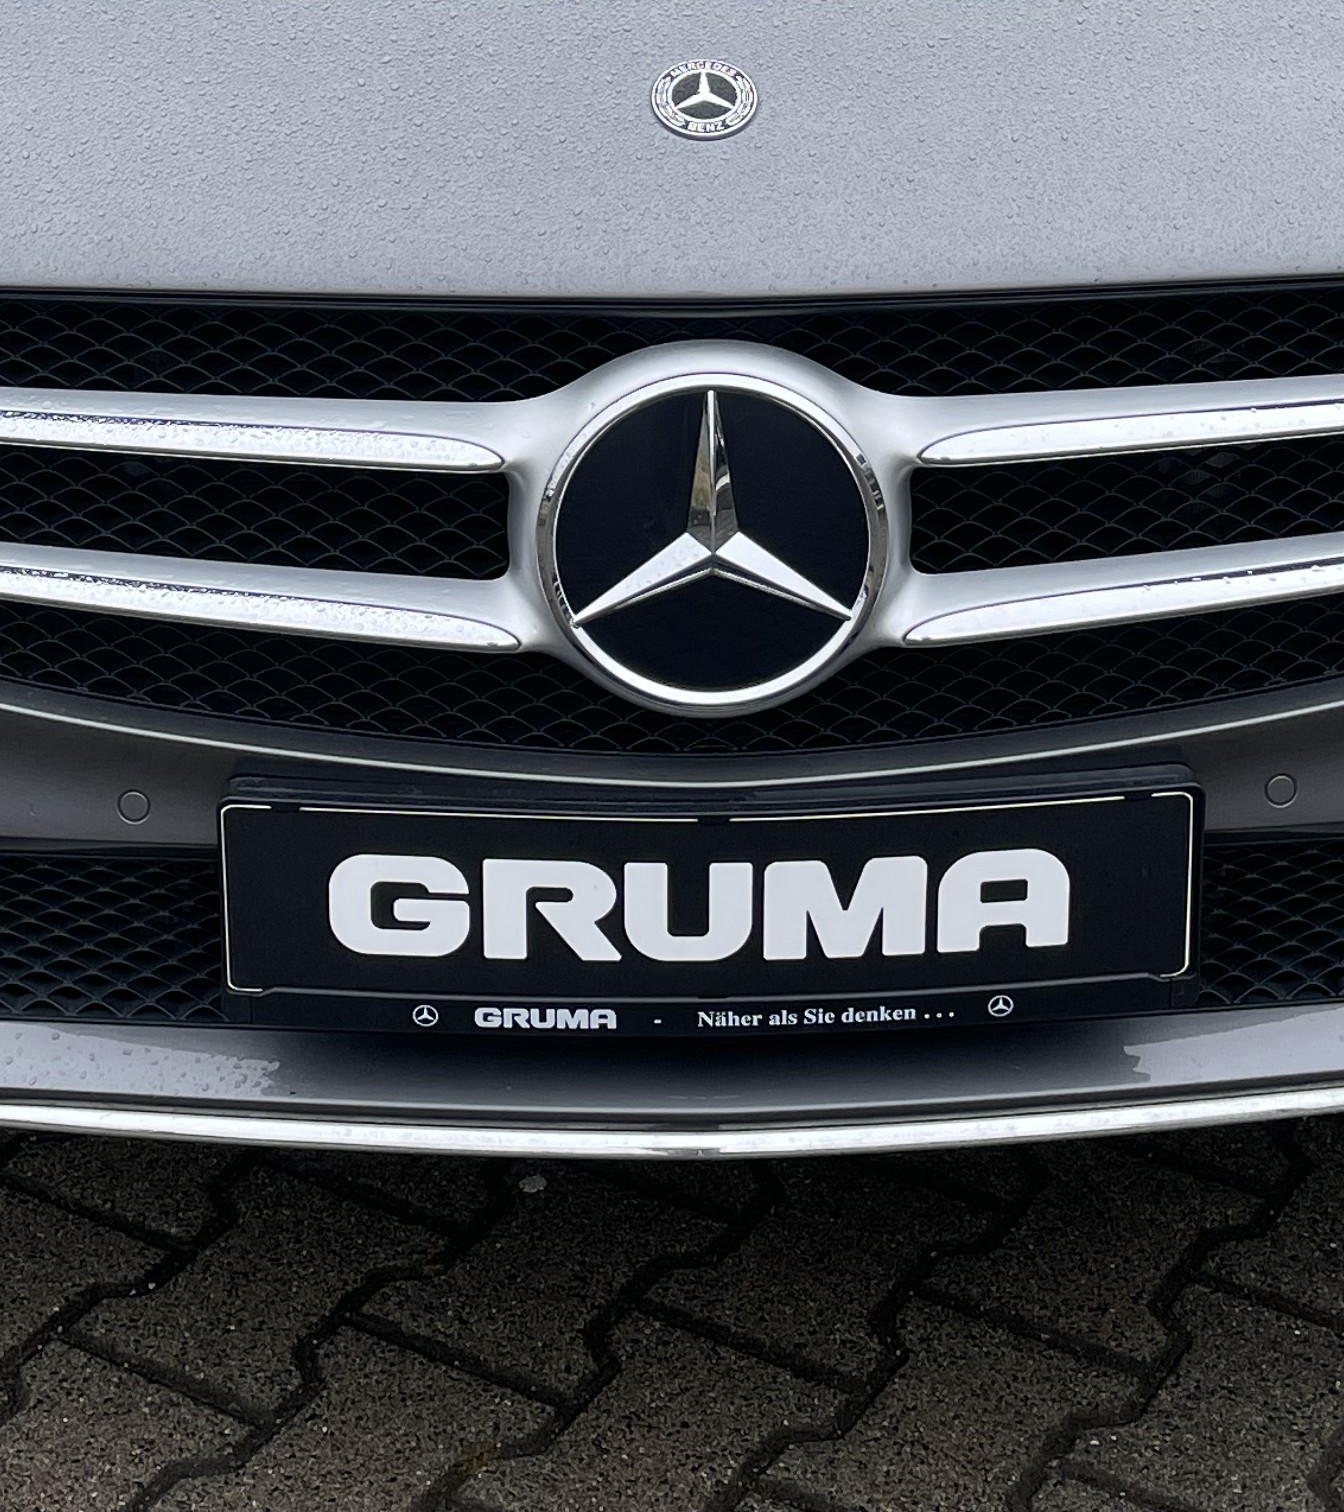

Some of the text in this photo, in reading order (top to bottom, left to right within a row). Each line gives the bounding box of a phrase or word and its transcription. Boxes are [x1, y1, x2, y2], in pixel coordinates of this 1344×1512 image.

[687, 121, 725, 132] BENZ
[328, 848, 1070, 962] GRUMA
[474, 1007, 617, 1030] GRUMA
[697, 1010, 763, 1028] Näher
[768, 1010, 798, 1026] als
[803, 1007, 835, 1025] Sie
[841, 1005, 916, 1023] denken
